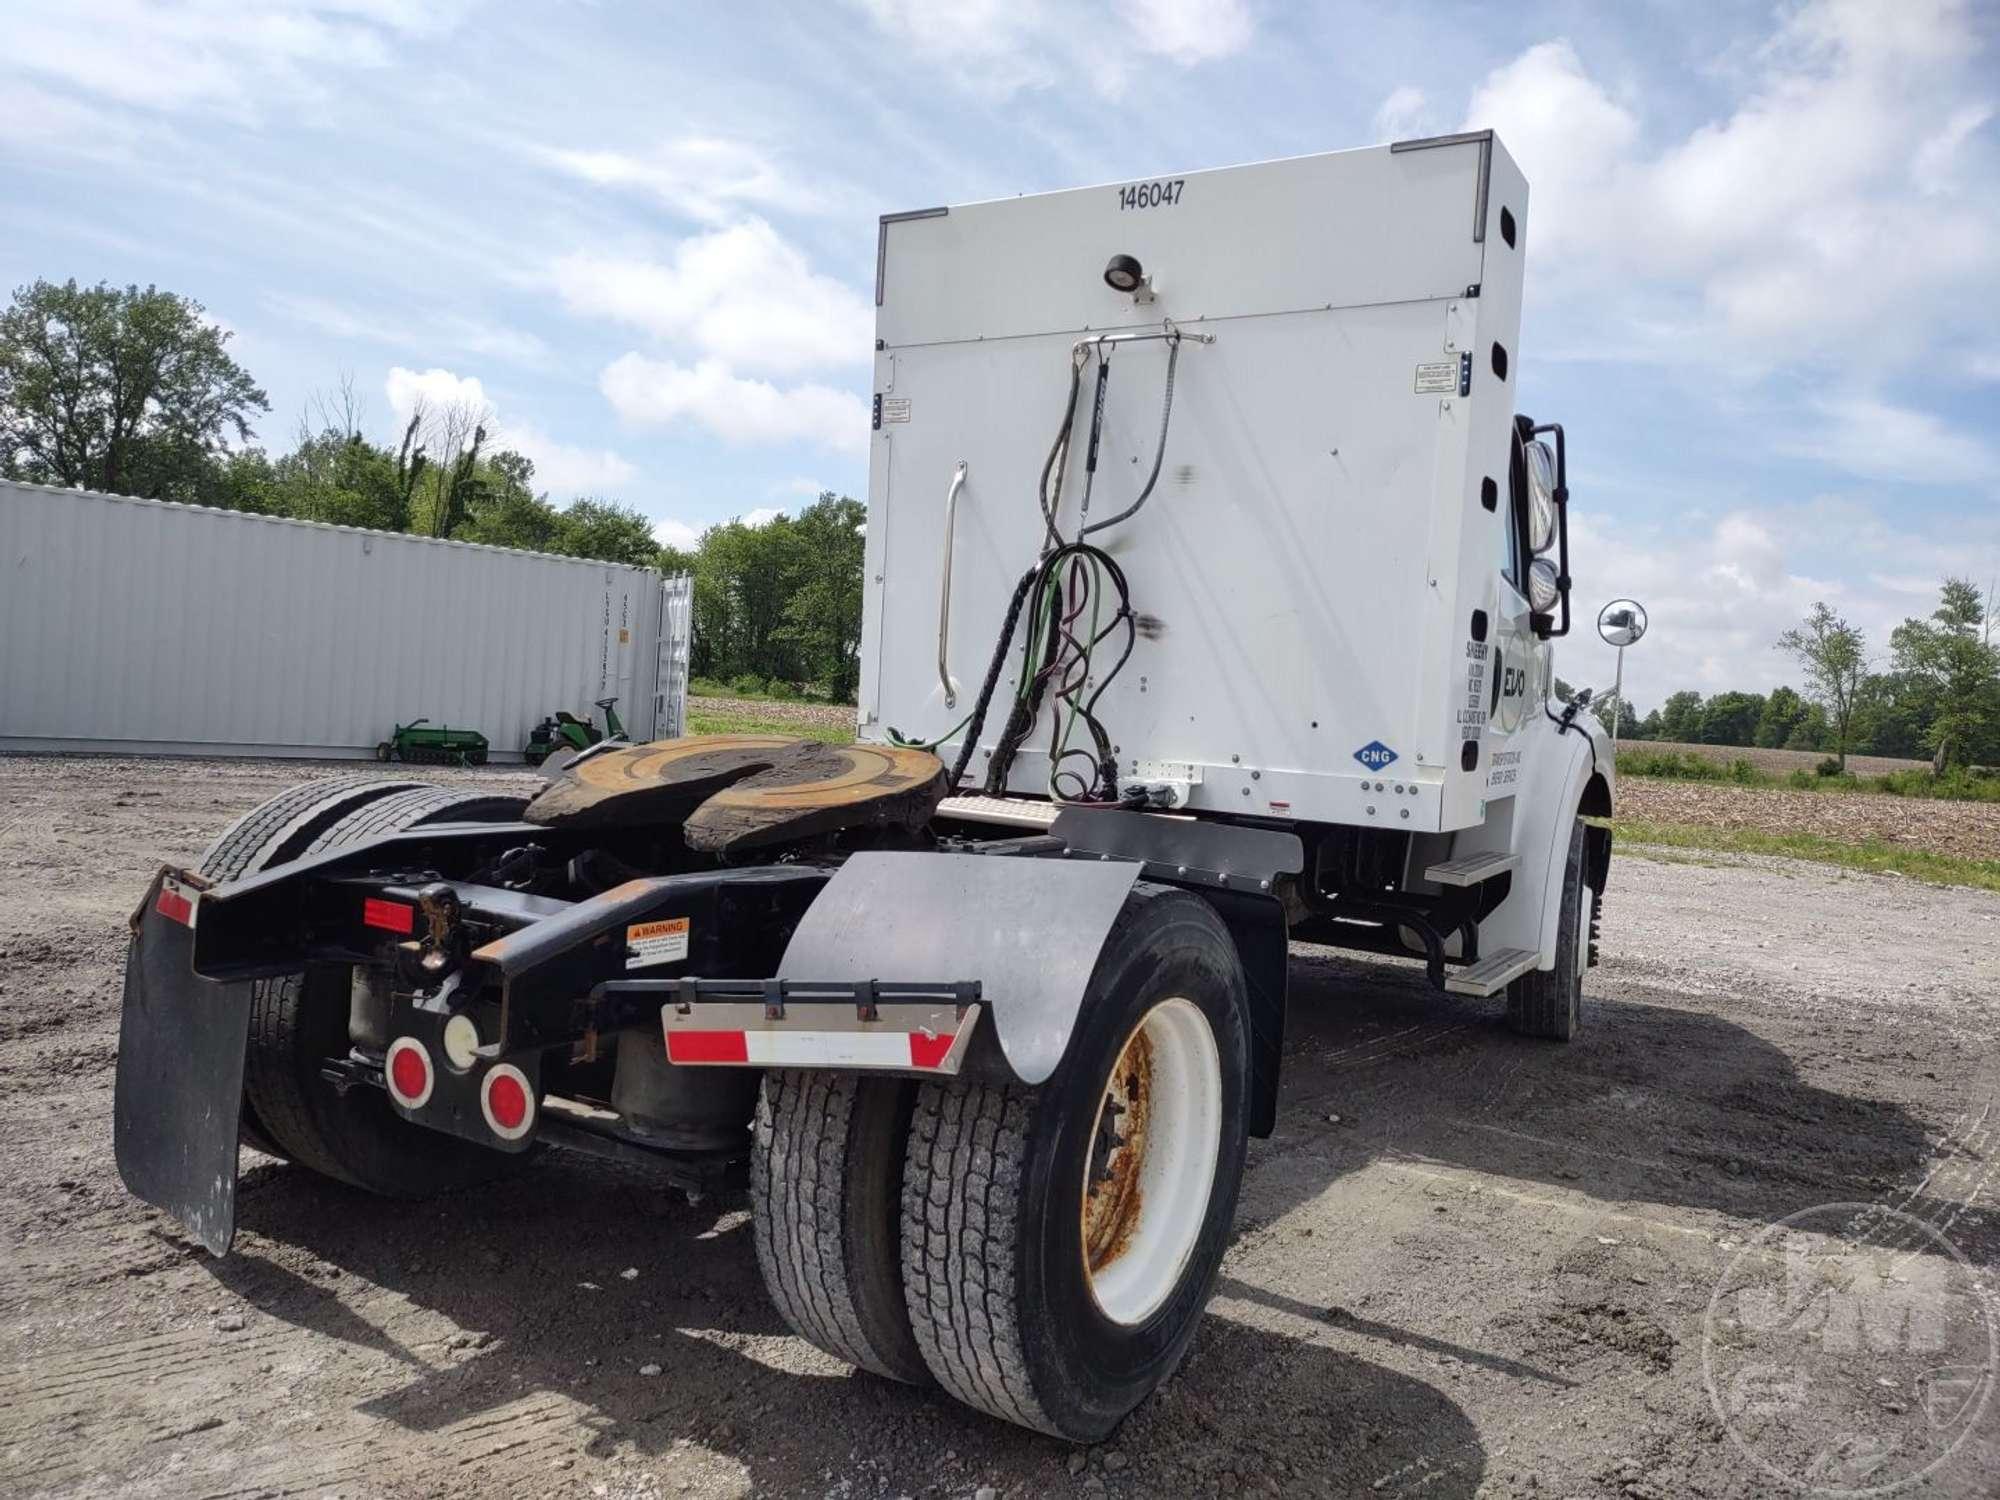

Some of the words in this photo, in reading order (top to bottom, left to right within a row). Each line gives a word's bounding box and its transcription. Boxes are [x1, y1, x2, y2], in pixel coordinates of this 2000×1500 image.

[1119, 180, 1184, 210] 146047
[1361, 750, 1390, 762] CNG
[642, 921, 684, 936] WARNING
